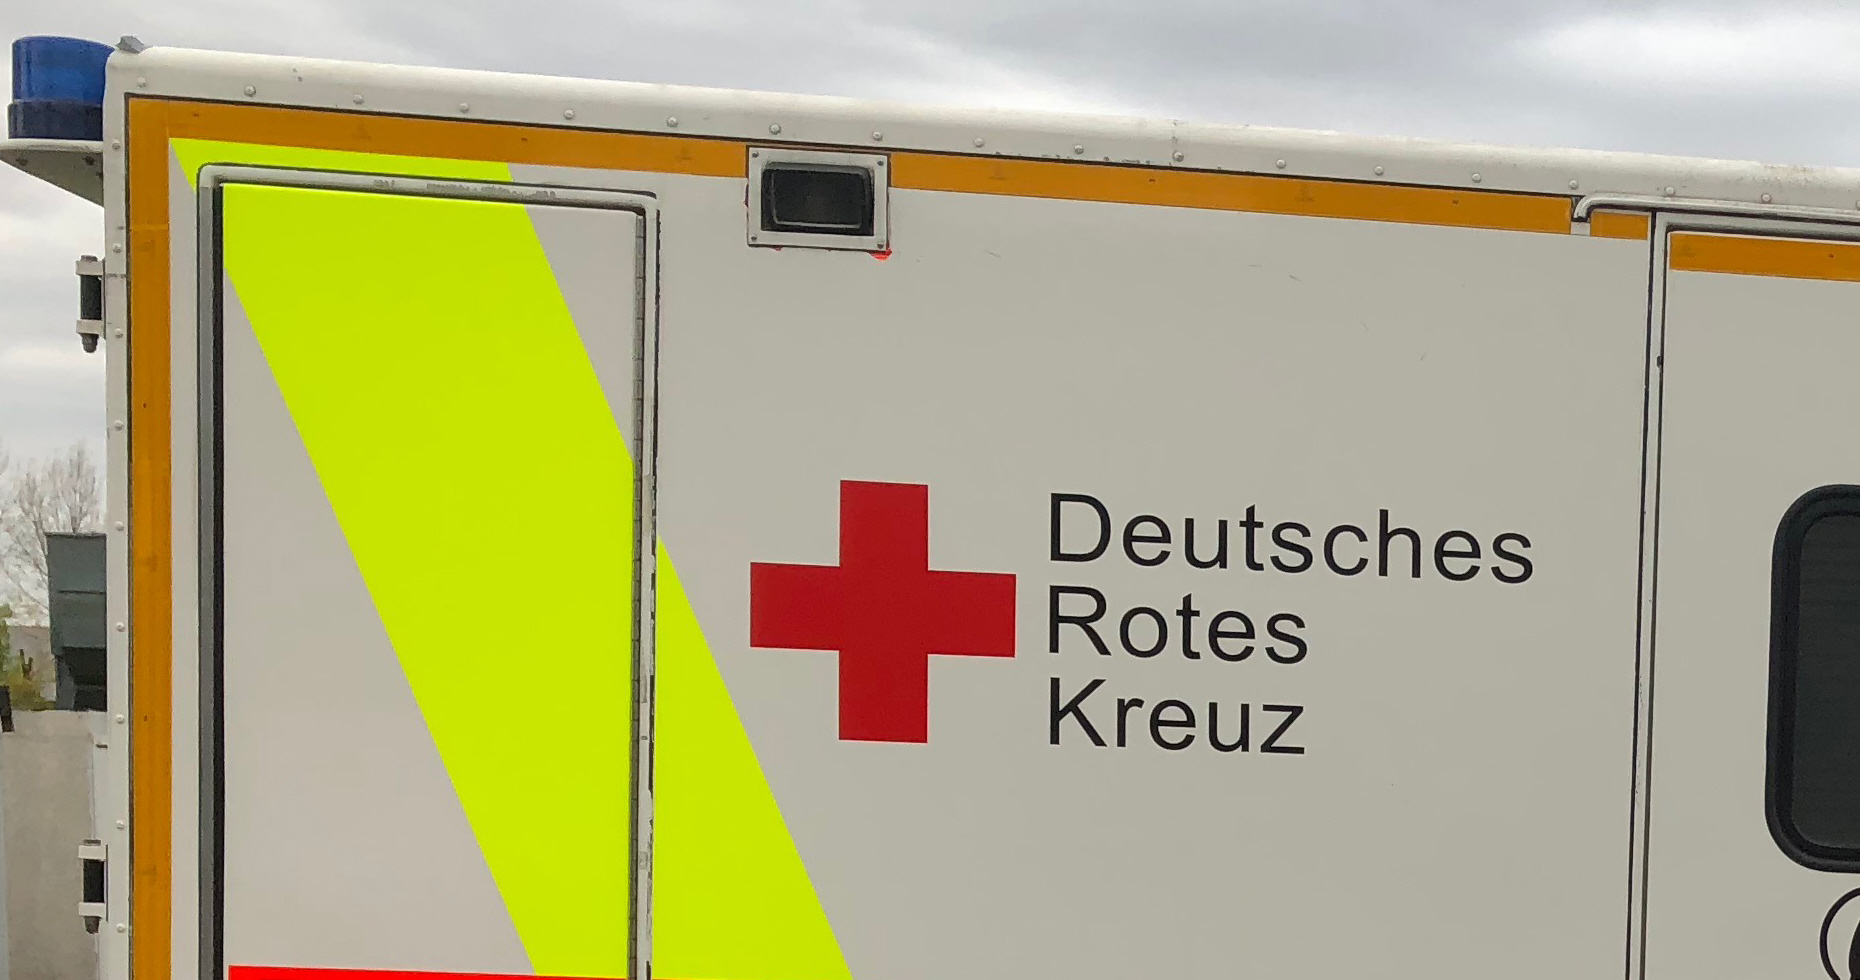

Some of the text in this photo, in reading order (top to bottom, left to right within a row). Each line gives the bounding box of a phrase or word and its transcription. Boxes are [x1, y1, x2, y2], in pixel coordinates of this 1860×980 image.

[1049, 492, 1535, 584] Deutsches
[1049, 585, 1309, 665] Rotes
[1049, 677, 1306, 755] Kreuz
